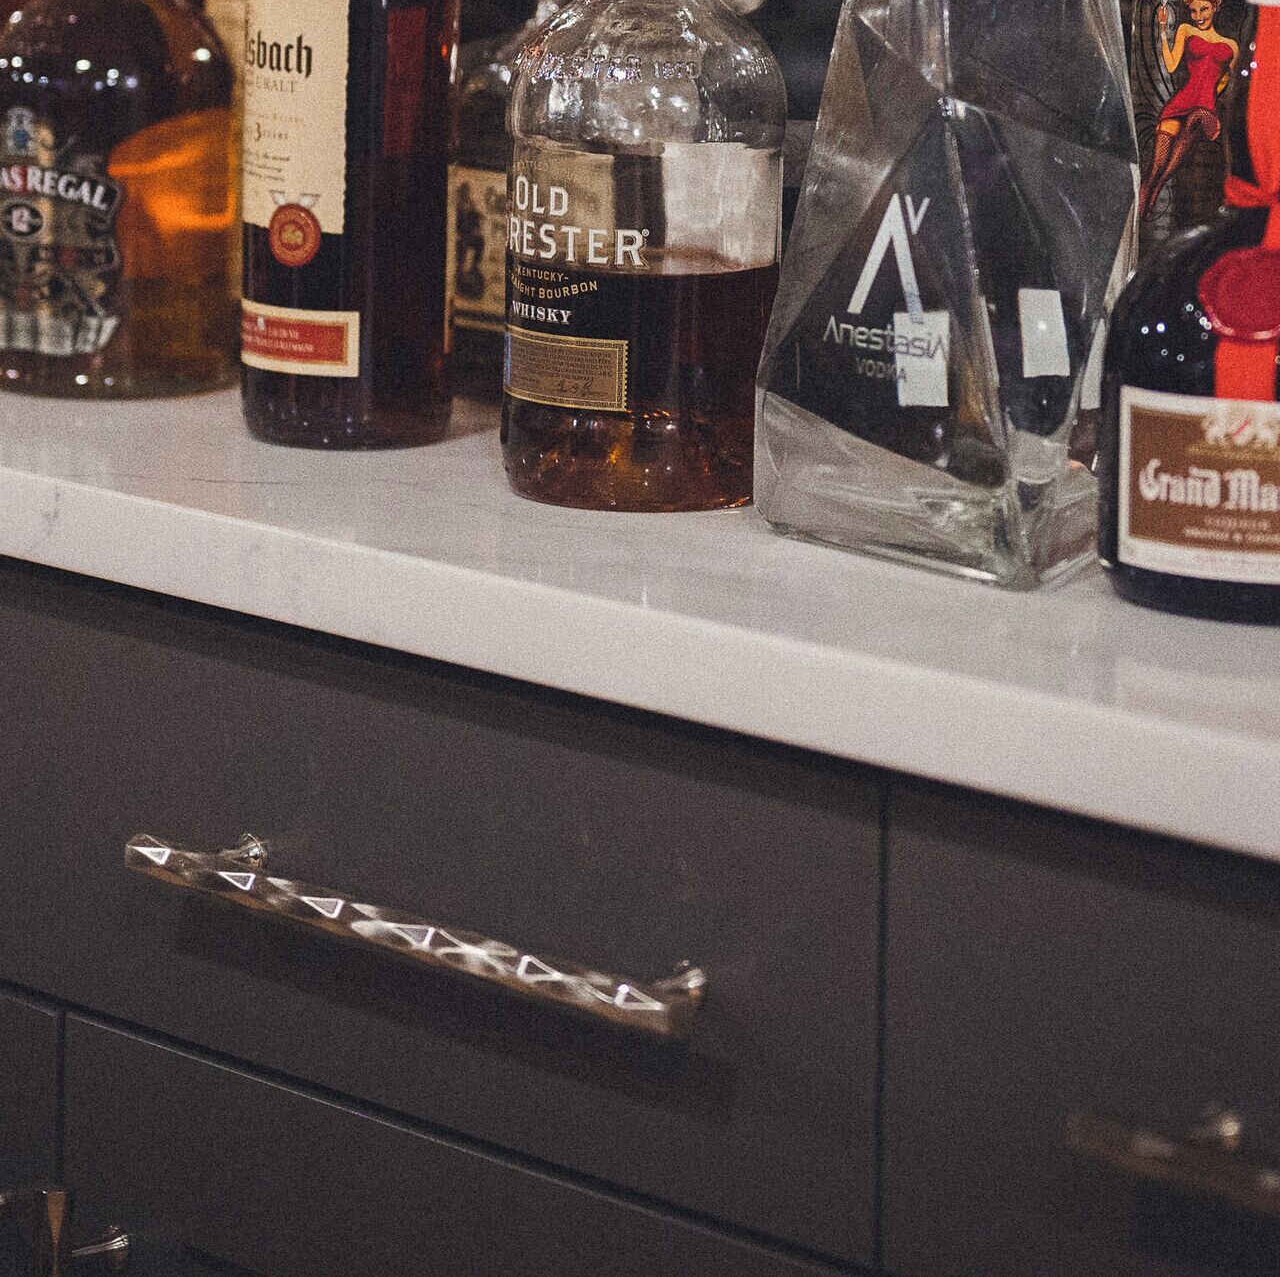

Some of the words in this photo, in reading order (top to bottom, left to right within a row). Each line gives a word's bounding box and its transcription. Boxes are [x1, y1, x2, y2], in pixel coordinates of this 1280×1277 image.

[245, 30, 313, 79] sbach
[26, 165, 108, 211] REGAL
[515, 174, 570, 217] OLD
[509, 216, 644, 267] RESTER
[511, 299, 571, 325] WHISKY
[538, 280, 599, 300] BOURBON
[856, 357, 908, 384] VODKA
[1138, 458, 1221, 508] Grand
